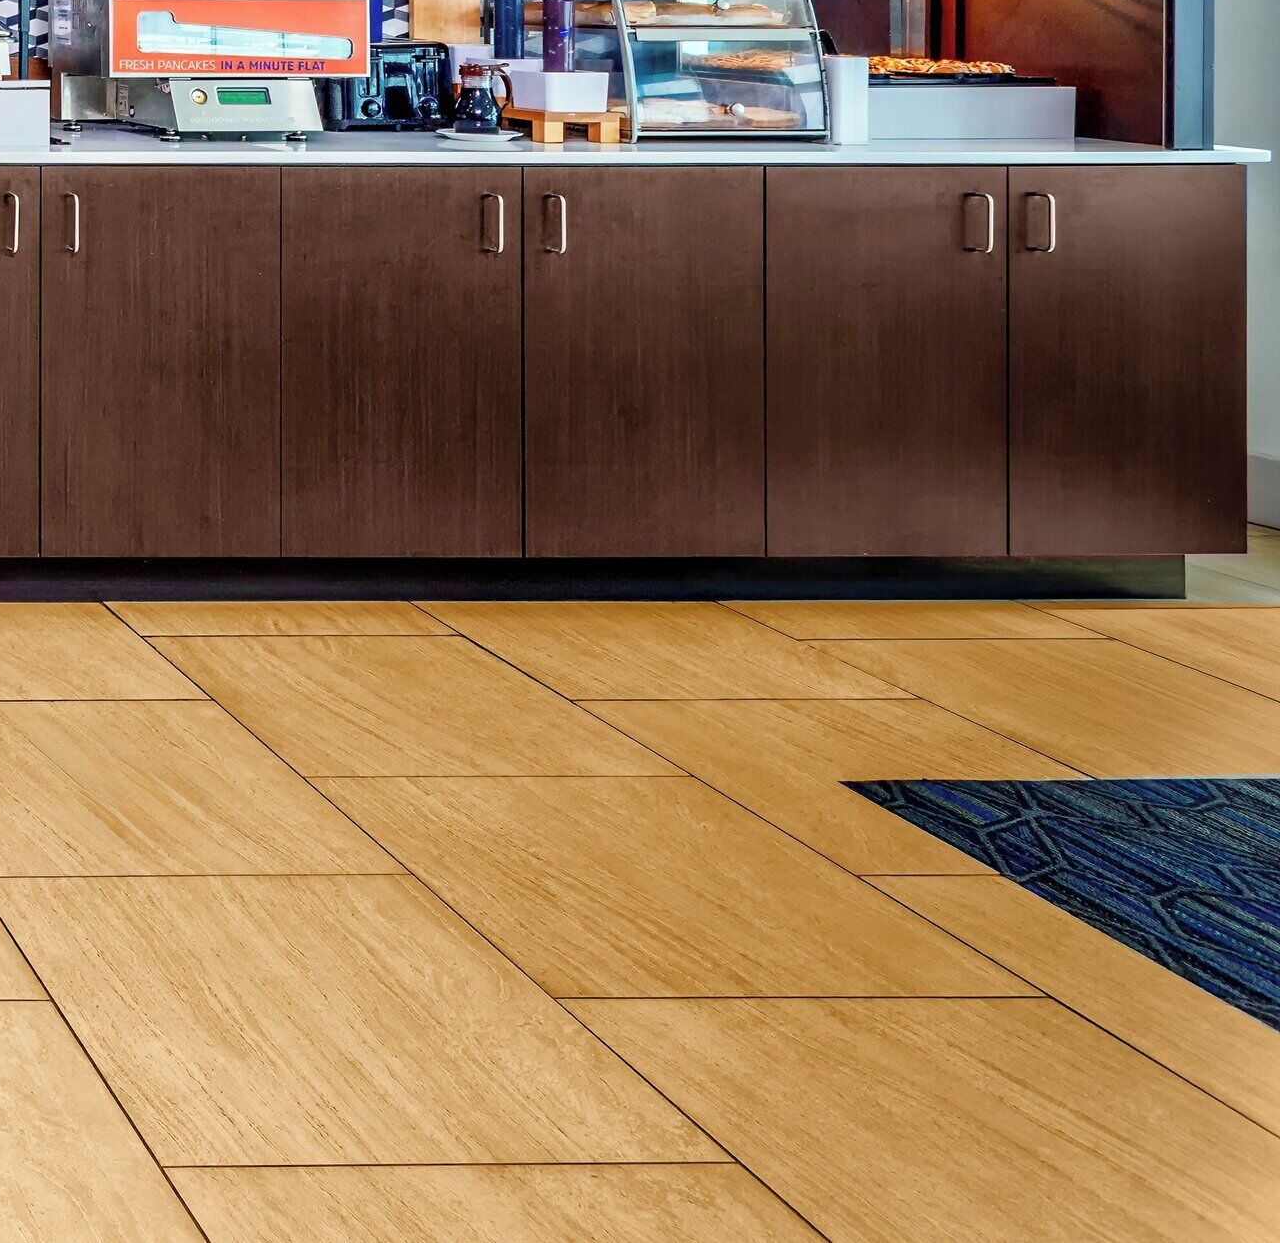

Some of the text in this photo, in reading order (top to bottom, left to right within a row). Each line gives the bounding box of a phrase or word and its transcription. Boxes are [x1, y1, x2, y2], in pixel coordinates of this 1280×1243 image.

[119, 60, 326, 71] FRESH PANCAKES IN A MINUTE FLAT
